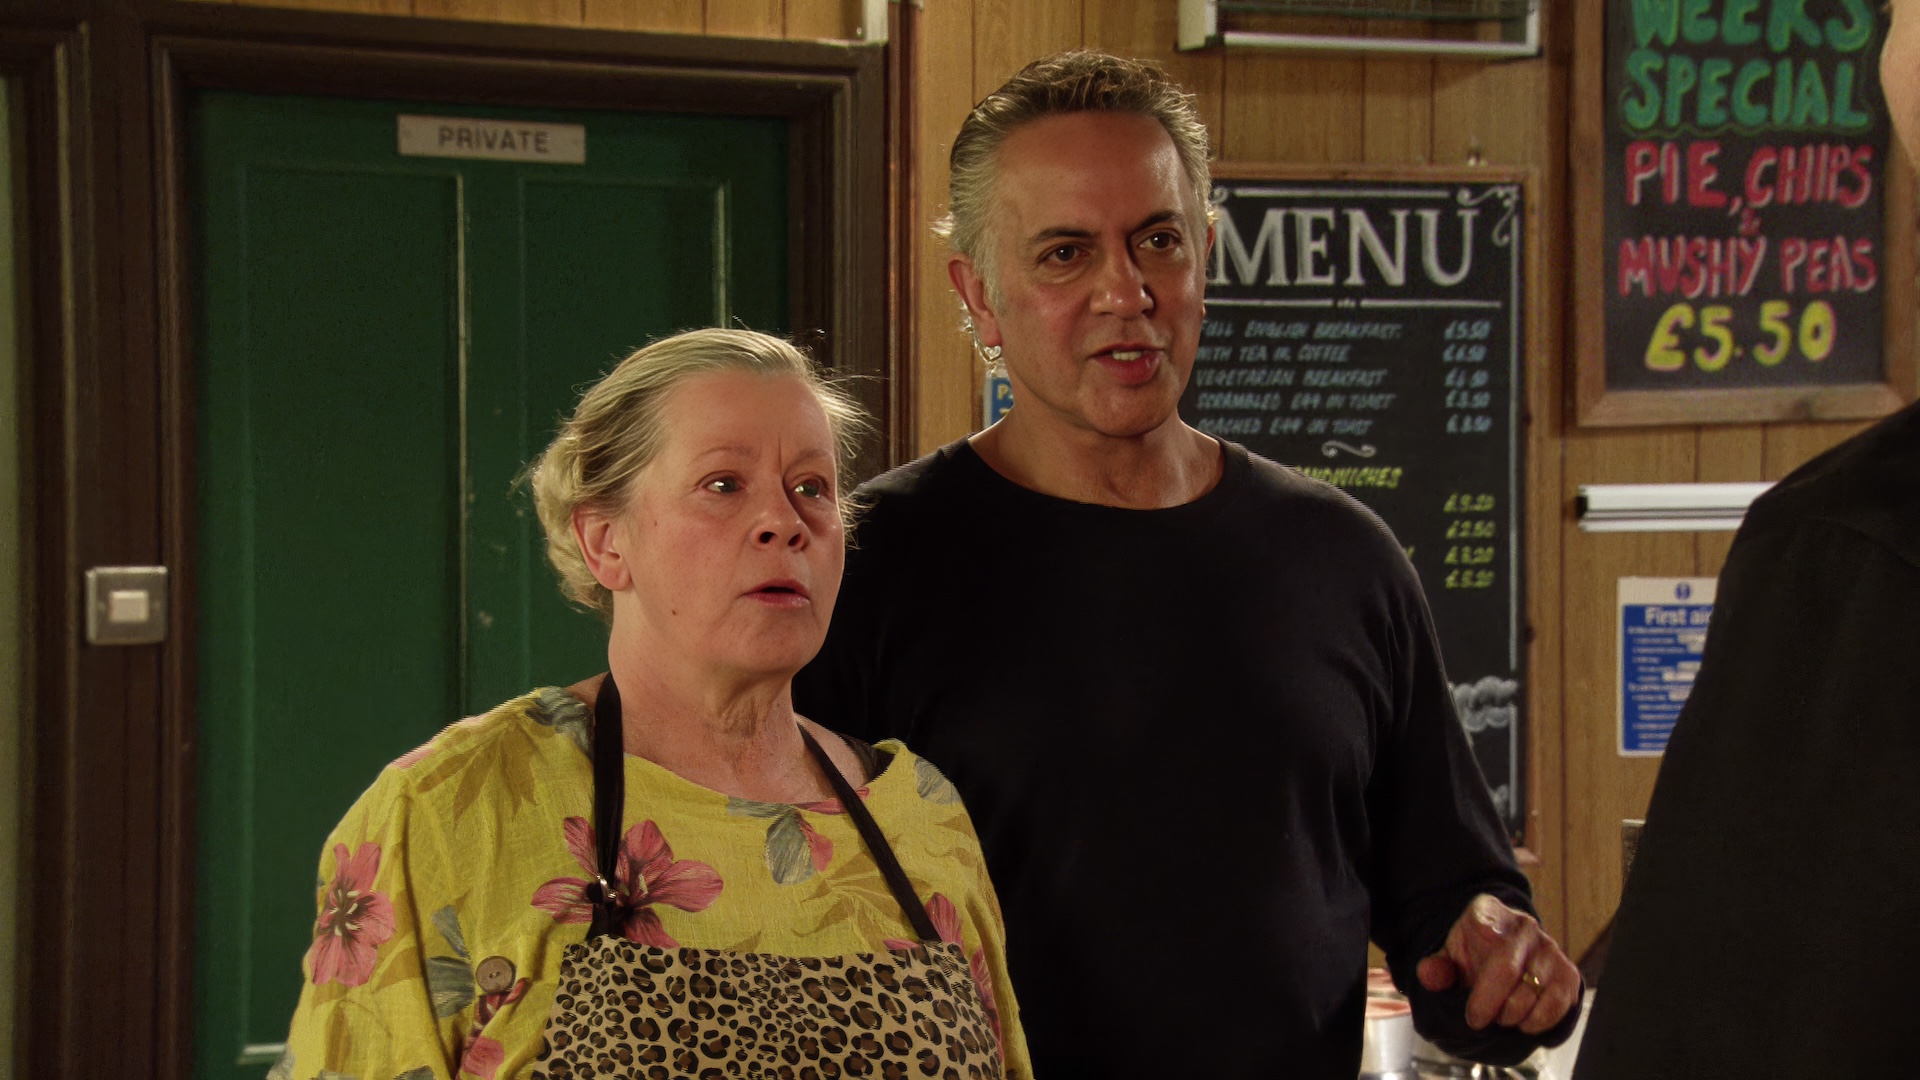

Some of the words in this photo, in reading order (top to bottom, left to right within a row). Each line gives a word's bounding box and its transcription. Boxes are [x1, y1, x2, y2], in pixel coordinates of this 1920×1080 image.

[1632, 0, 1873, 51] WEEKS
[1623, 51, 1870, 130] SPECIAL
[438, 126, 549, 154] PRIVATE
[1625, 141, 1743, 215] PIE,
[1745, 143, 1873, 208] CHIPS
[1206, 207, 1480, 287] MENU
[1618, 235, 1767, 298] MUSHY
[1779, 235, 1877, 293] PEAS
[1244, 320, 1310, 338] ENGLISH
[1644, 300, 1836, 371] £5.50
[1239, 344, 1267, 362] TEA
[1297, 344, 1351, 362] COFFEE
[1196, 368, 1296, 386] VEGETARIAN
[1302, 369, 1388, 387] BREAKFAST
[1196, 392, 1281, 410] SCRAMBLED
[1349, 393, 1397, 410] TOAST
[1332, 418, 1373, 436] TOAST
[1645, 606, 1687, 627] First
